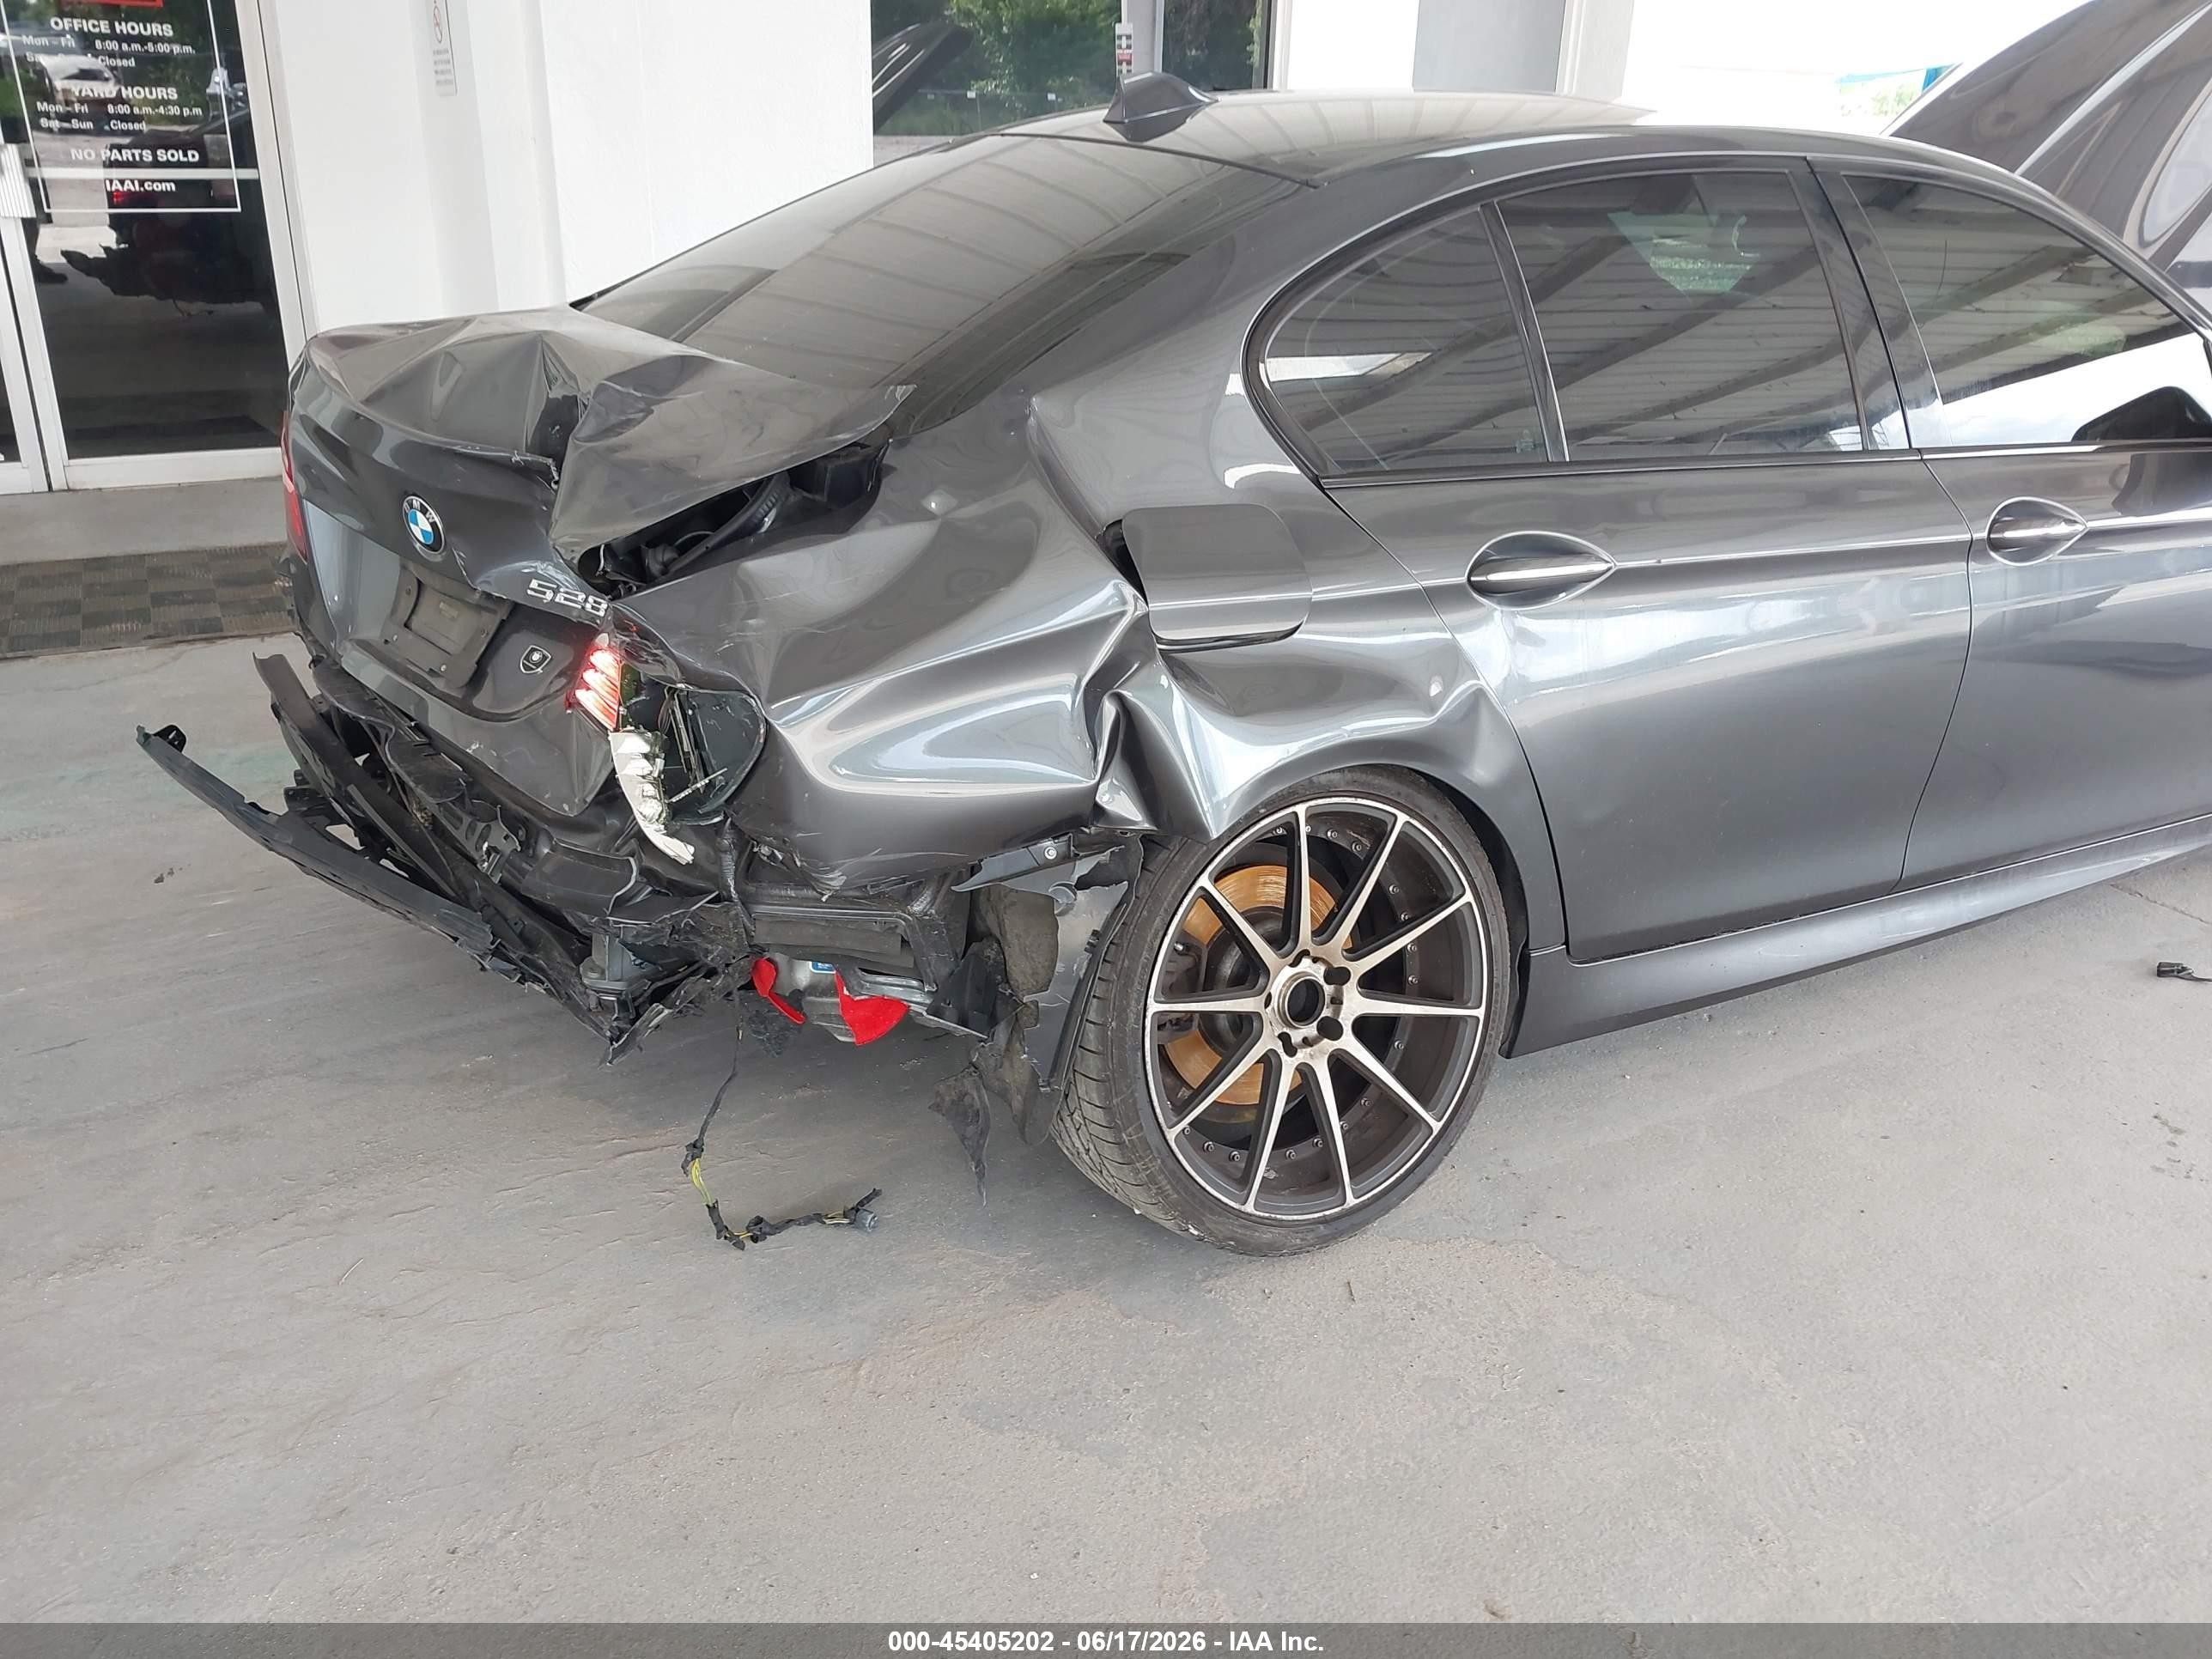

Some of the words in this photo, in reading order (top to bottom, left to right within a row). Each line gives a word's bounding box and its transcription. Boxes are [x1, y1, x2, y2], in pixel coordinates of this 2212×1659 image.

[50, 16, 111, 34] OFFICE
[115, 21, 173, 37] HOURS
[21, 34, 49, 47] Mon
[173, 45, 196, 55] p.m.
[98, 54, 136, 68] Closed
[70, 85, 117, 99] YARD
[120, 87, 178, 100] HOURS
[36, 101, 63, 113] Mon
[74, 102, 88, 114] Fri
[106, 103, 131, 115] 8:00
[70, 118, 94, 131] Sun
[110, 119, 146, 131] Closed
[70, 148, 96, 161] NO
[100, 148, 153, 162] PARTS
[156, 149, 200, 163] SOLD
[105, 179, 176, 192] IAAI.com
[526, 579, 608, 617] 528
